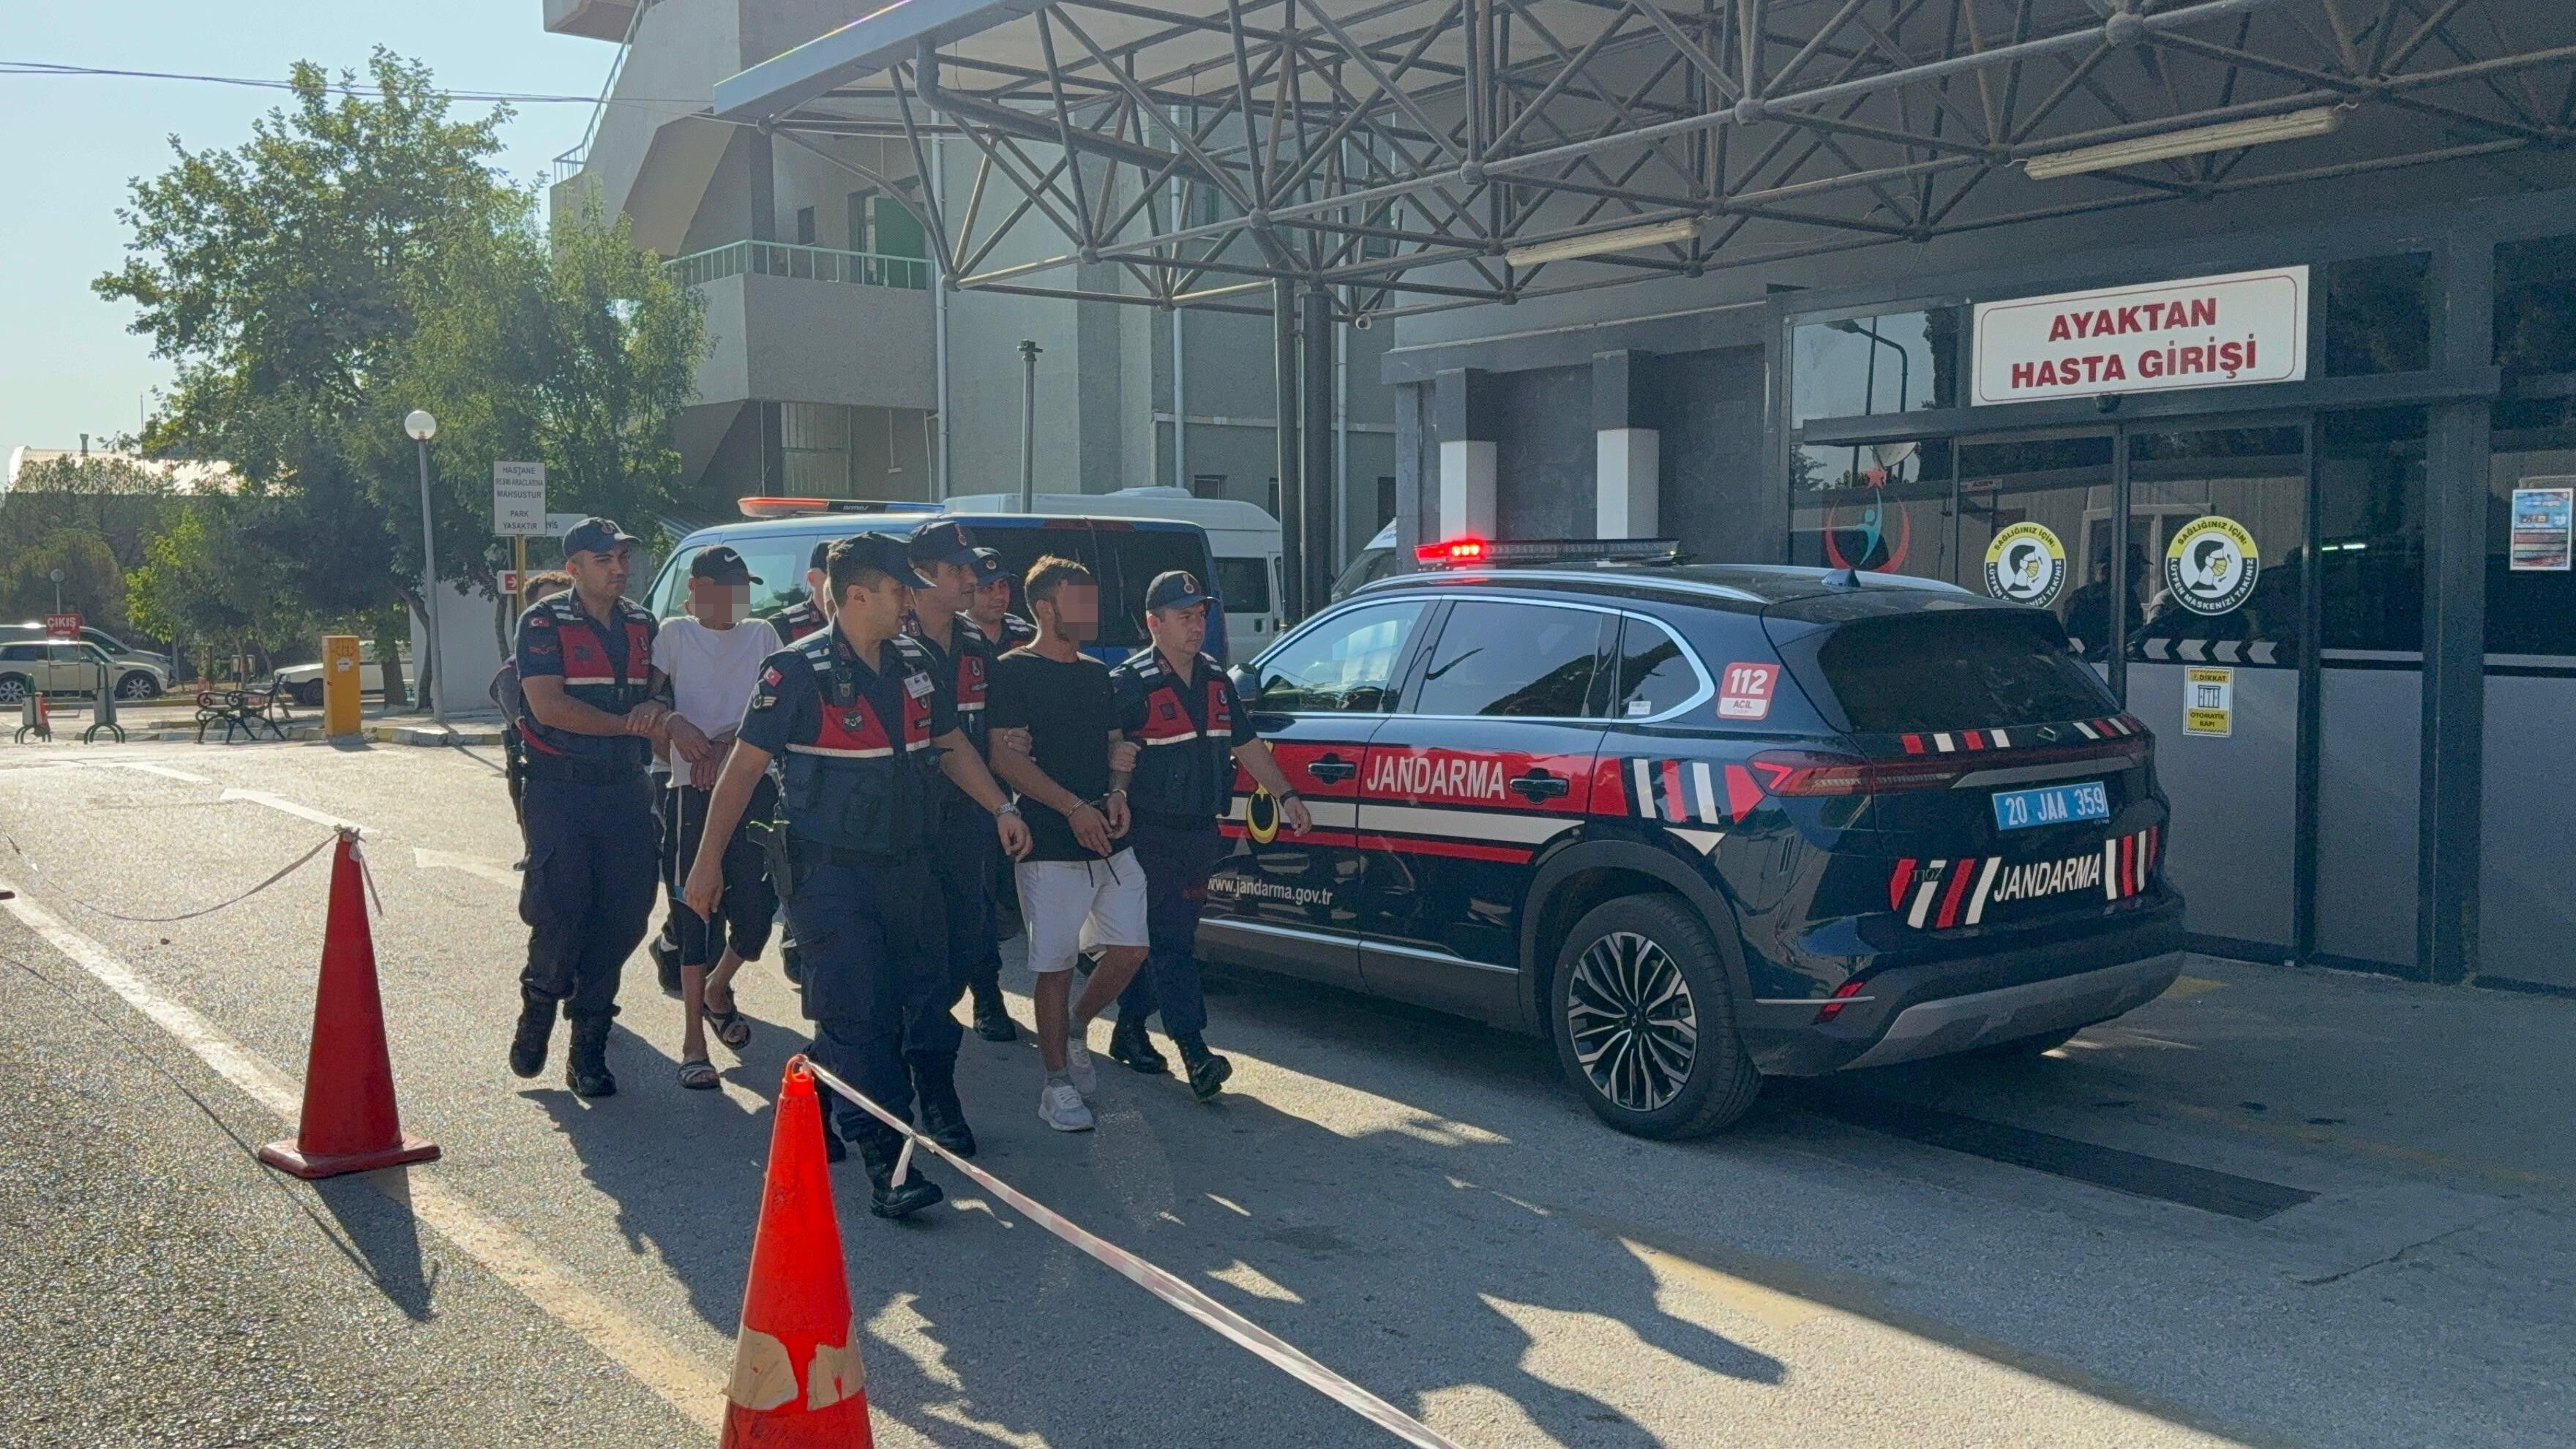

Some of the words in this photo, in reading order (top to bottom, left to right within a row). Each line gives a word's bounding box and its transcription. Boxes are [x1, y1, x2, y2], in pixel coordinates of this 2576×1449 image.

[2048, 298, 2216, 342] AYAKTAN
[2012, 353, 2126, 389] HASTA
[2138, 333, 2256, 379] GİRİŞİ
[503, 466, 536, 475] HASTANE
[497, 490, 542, 498] MAHSUSTUR
[503, 522, 538, 530] YASAKTIR
[510, 509, 528, 517] PARK
[1988, 563, 2003, 597] LÜTFEN
[2045, 559, 2062, 596] TAKINIZ
[2170, 558, 2185, 595] LÜTFEN
[2184, 594, 2236, 610] MASKENİZİ
[2234, 558, 2254, 598] TAKINIZ
[47, 617, 77, 630] ÇIKIŞ
[1731, 668, 1768, 695] 112
[2199, 673, 2226, 682] DİKKAT
[1367, 755, 1505, 800] JANDARMA
[2005, 795, 2028, 825] 20
[2037, 791, 2068, 821] JAA
[2074, 787, 2105, 817] 359
[1208, 877, 1333, 906] www.jandarma.gov.tr
[1993, 853, 2101, 902] JANDARMA
